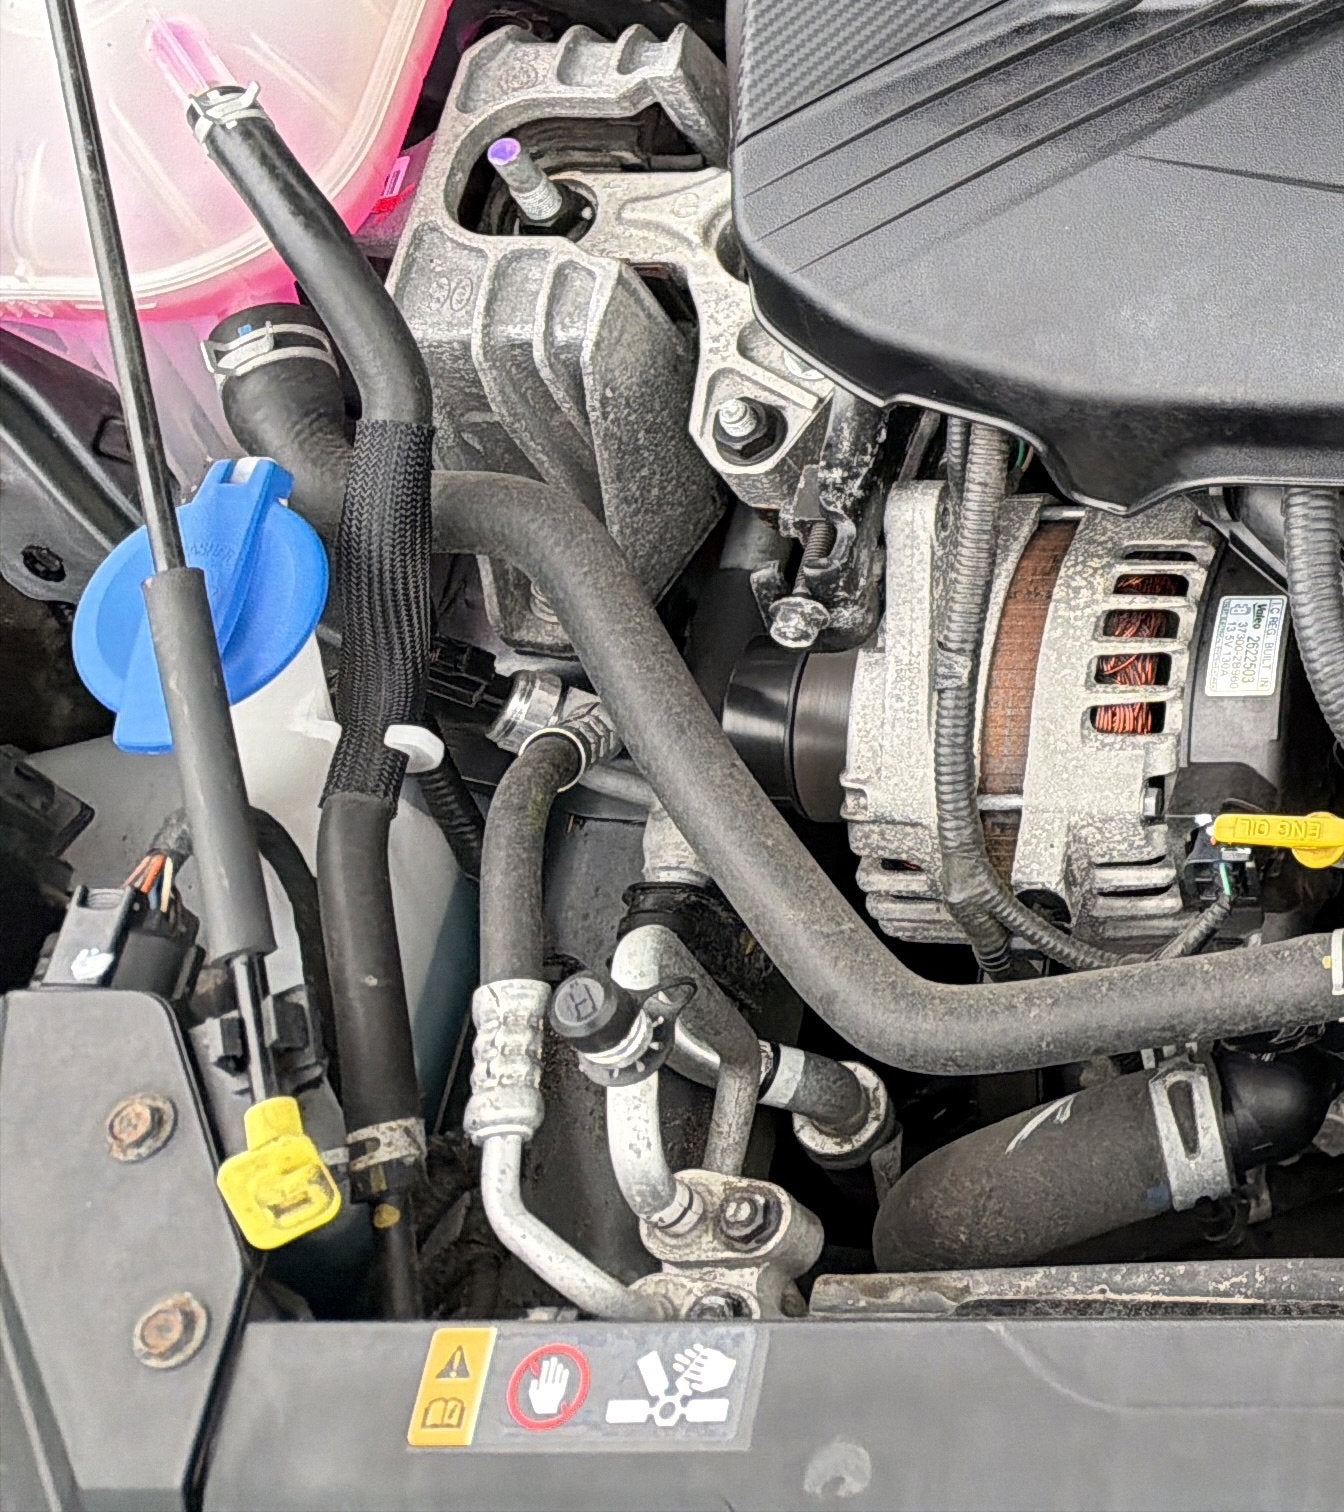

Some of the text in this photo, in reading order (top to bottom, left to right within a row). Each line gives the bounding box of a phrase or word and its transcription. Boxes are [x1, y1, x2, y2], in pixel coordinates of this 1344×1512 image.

[1241, 635, 1261, 684] 2622503
[1262, 642, 1275, 670] BUILT
[1239, 818, 1322, 840] ENG OIL
